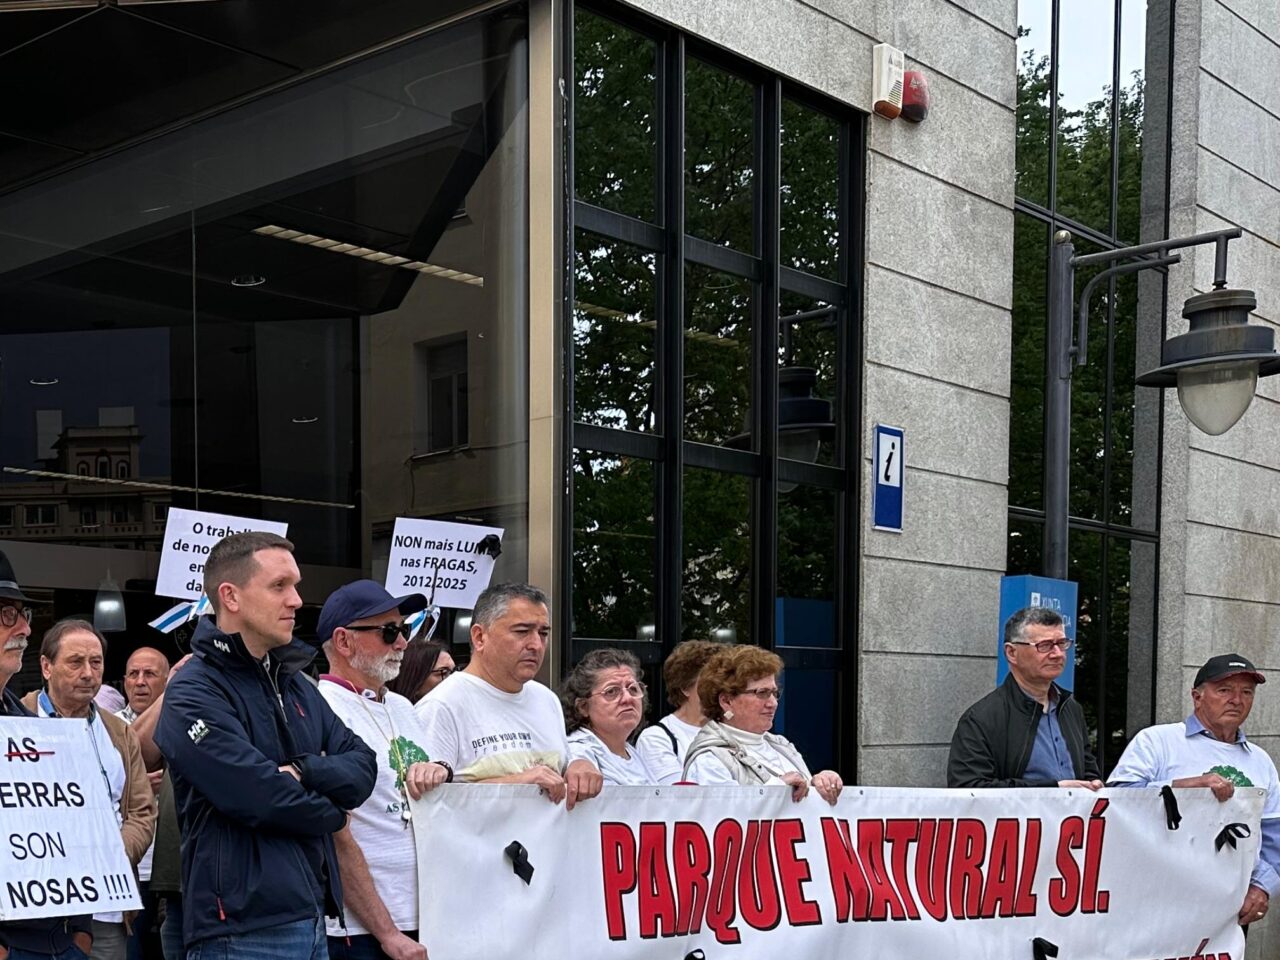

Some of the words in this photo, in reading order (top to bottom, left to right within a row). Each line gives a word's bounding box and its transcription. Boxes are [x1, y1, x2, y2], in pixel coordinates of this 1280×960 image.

[192, 522, 204, 534] O
[172, 539, 190, 552] de
[394, 535, 422, 549] NON
[424, 538, 454, 551] mais
[456, 540, 492, 556] LUM
[189, 563, 205, 573] en
[400, 558, 421, 568] nas
[423, 557, 478, 575] FRAGAS,
[186, 579, 203, 592] da
[187, 719, 206, 740] HH
[6, 737, 40, 762] AS
[471, 734, 500, 749] DEFINE
[499, 732, 517, 741] YOUR
[8, 832, 67, 860] SON
[600, 817, 822, 944] PARQUE
[819, 816, 1042, 923] NATURAL
[1047, 798, 1111, 917] SÍ.
[6, 876, 99, 909] NOSAS
